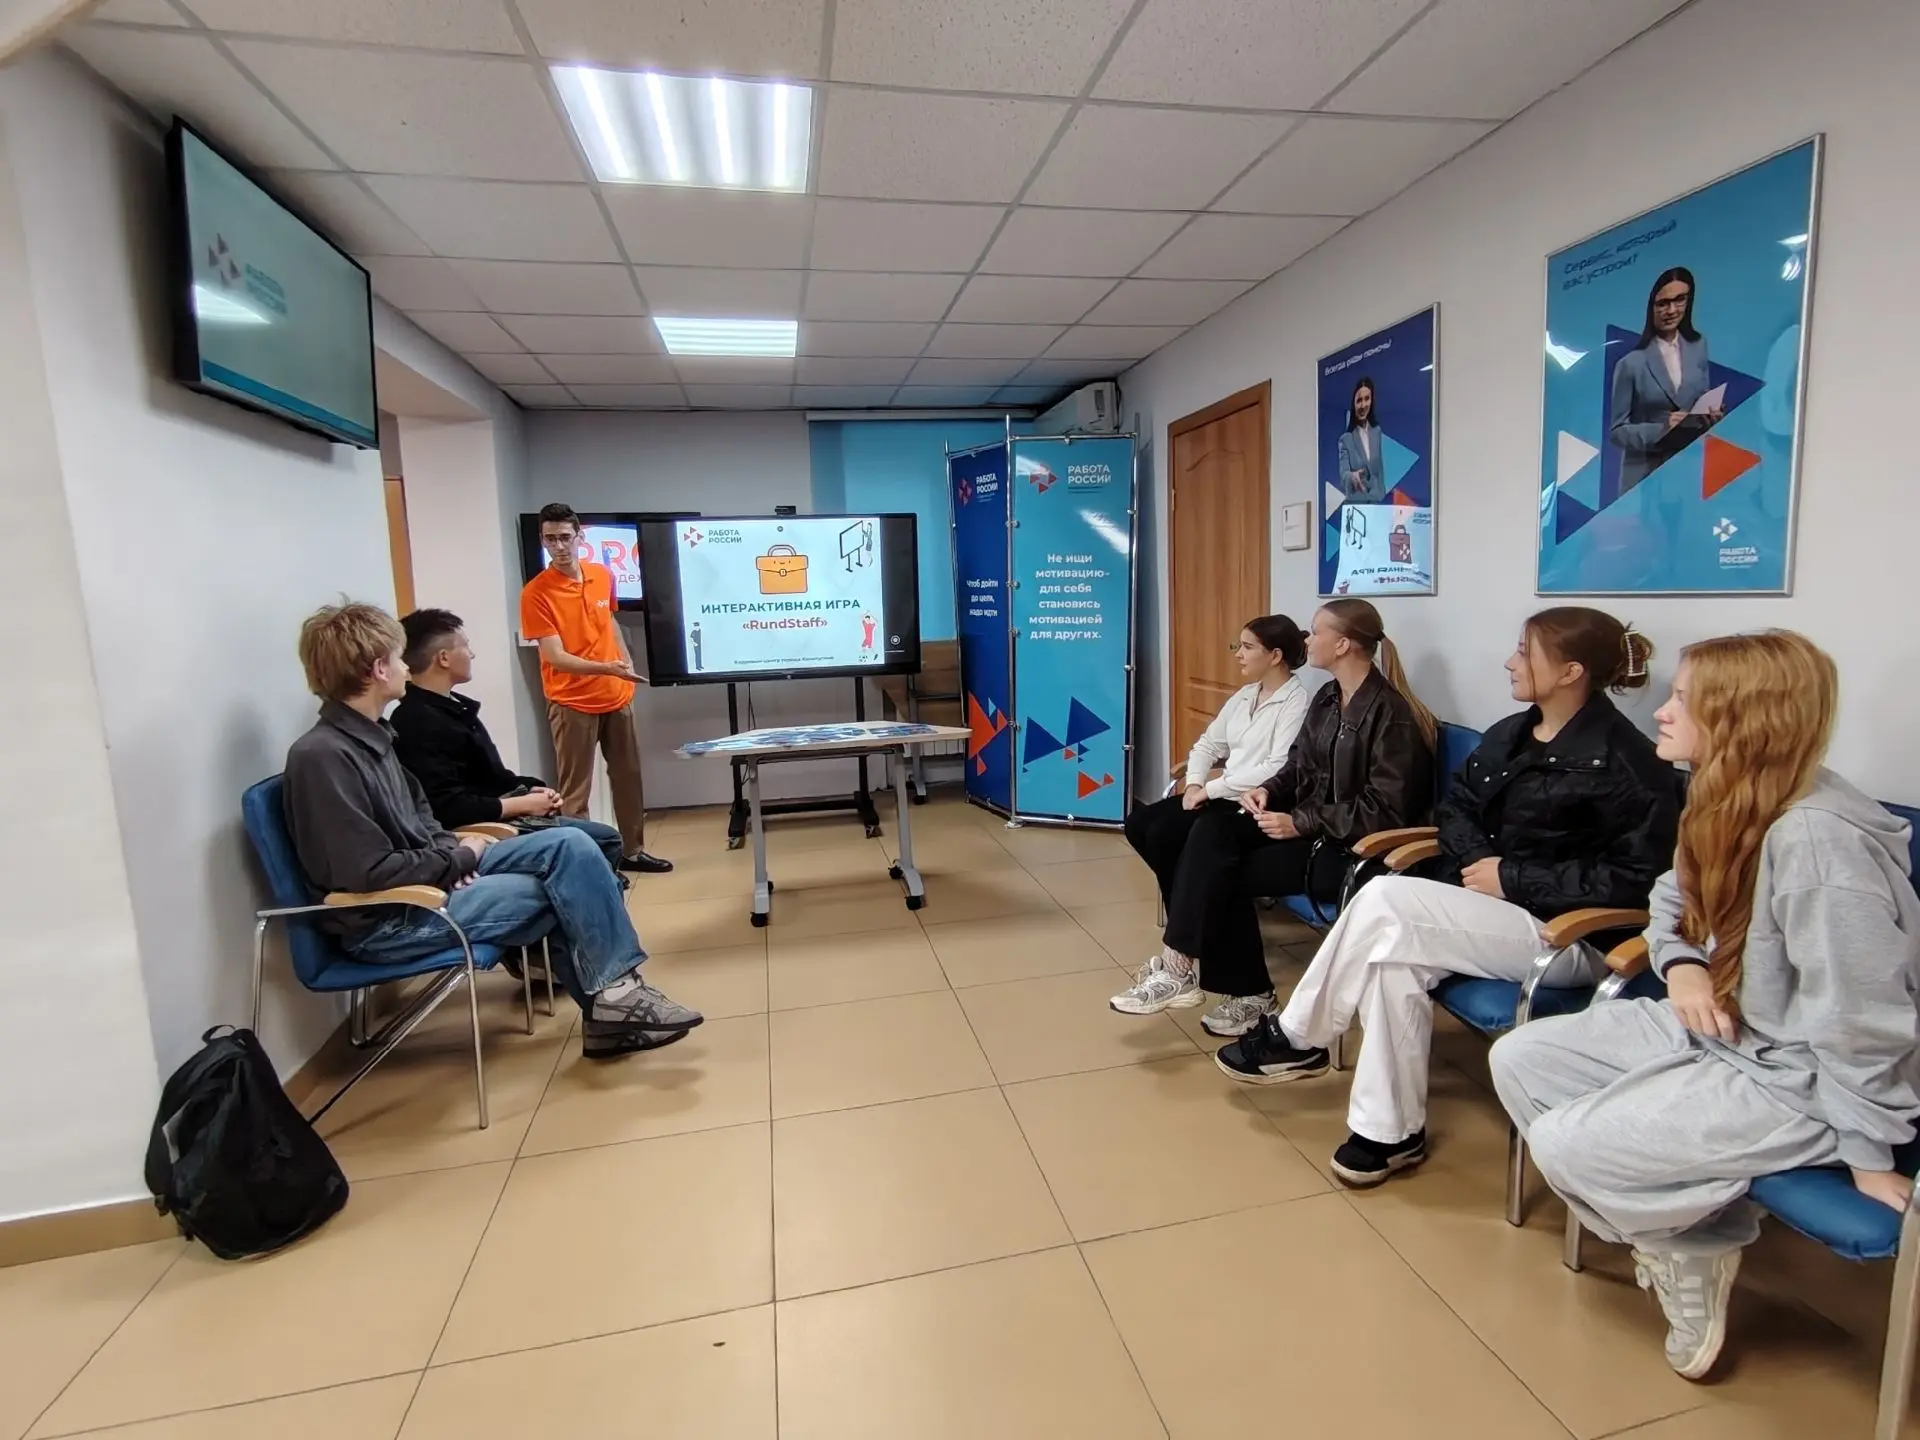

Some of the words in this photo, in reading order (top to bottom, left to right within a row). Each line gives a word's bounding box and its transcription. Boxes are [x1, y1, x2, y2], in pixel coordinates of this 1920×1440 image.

[1068, 464, 1110, 474] РАБОТА
[976, 473, 997, 484] РАБОТА
[1068, 475, 1112, 484] РОССИИ
[976, 482, 998, 494] РОССИИ
[708, 529, 740, 537] РАБОТА
[708, 536, 742, 544] РОССИИ
[1047, 554, 1063, 563] Не
[1066, 554, 1092, 563] ищи
[966, 578, 981, 588] Чтоб
[980, 578, 998, 588] дойти
[1040, 585, 1060, 594] для
[1063, 583, 1092, 593] себя
[970, 595, 979, 603] до
[701, 600, 822, 614] ИНТЕРАКТИВНАЯ
[825, 599, 861, 610] ИГРА
[1038, 600, 1101, 609] становись
[742, 617, 828, 630] «RundStaff»
[1029, 613, 1103, 625] мотивацией
[1031, 631, 1052, 640] для
[1054, 631, 1102, 641] других.
